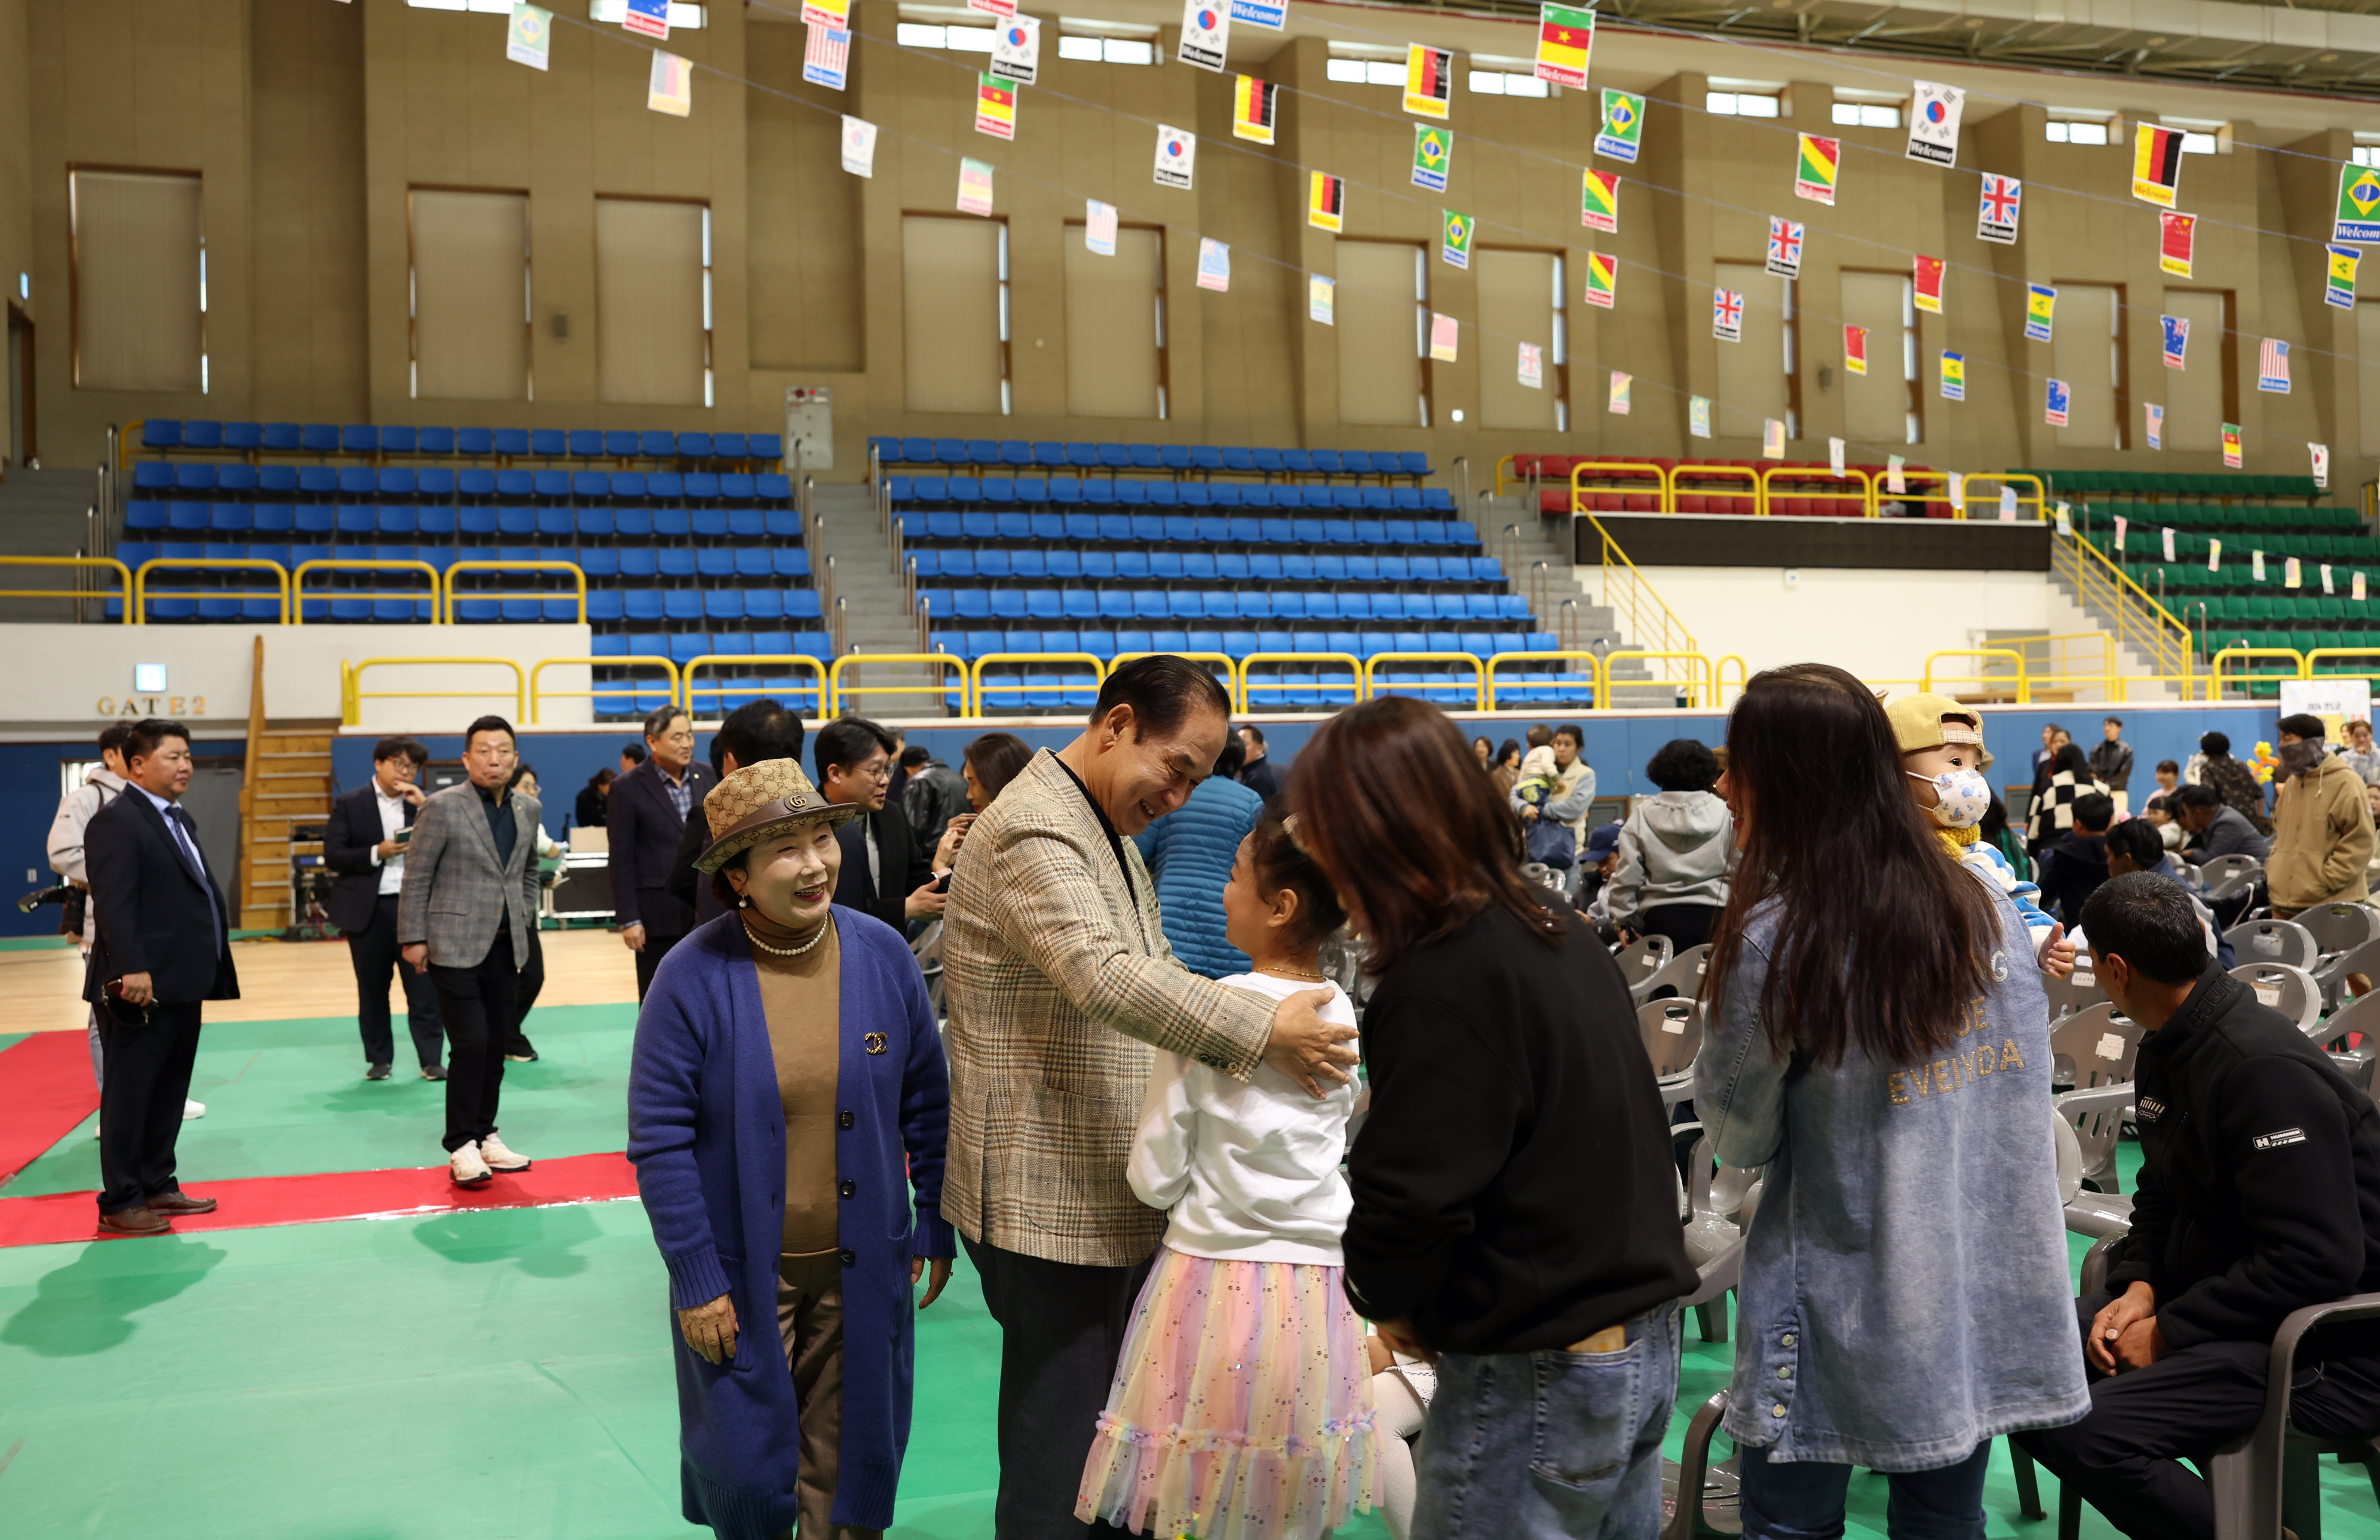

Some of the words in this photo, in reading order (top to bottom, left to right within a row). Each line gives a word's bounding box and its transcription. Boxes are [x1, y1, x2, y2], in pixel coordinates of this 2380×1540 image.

[1233, 2, 1281, 24] Welcome
[1182, 47, 1221, 66] Welcome
[1538, 65, 1584, 85] Welcome
[1599, 140, 1635, 158] Welcome
[1910, 142, 1952, 162] Welcome
[2134, 183, 2172, 201] Welcome
[1981, 223, 2013, 239] Welcome
[2338, 225, 2380, 239] Welcom
[2270, 1130, 2301, 1140] HUMMER
